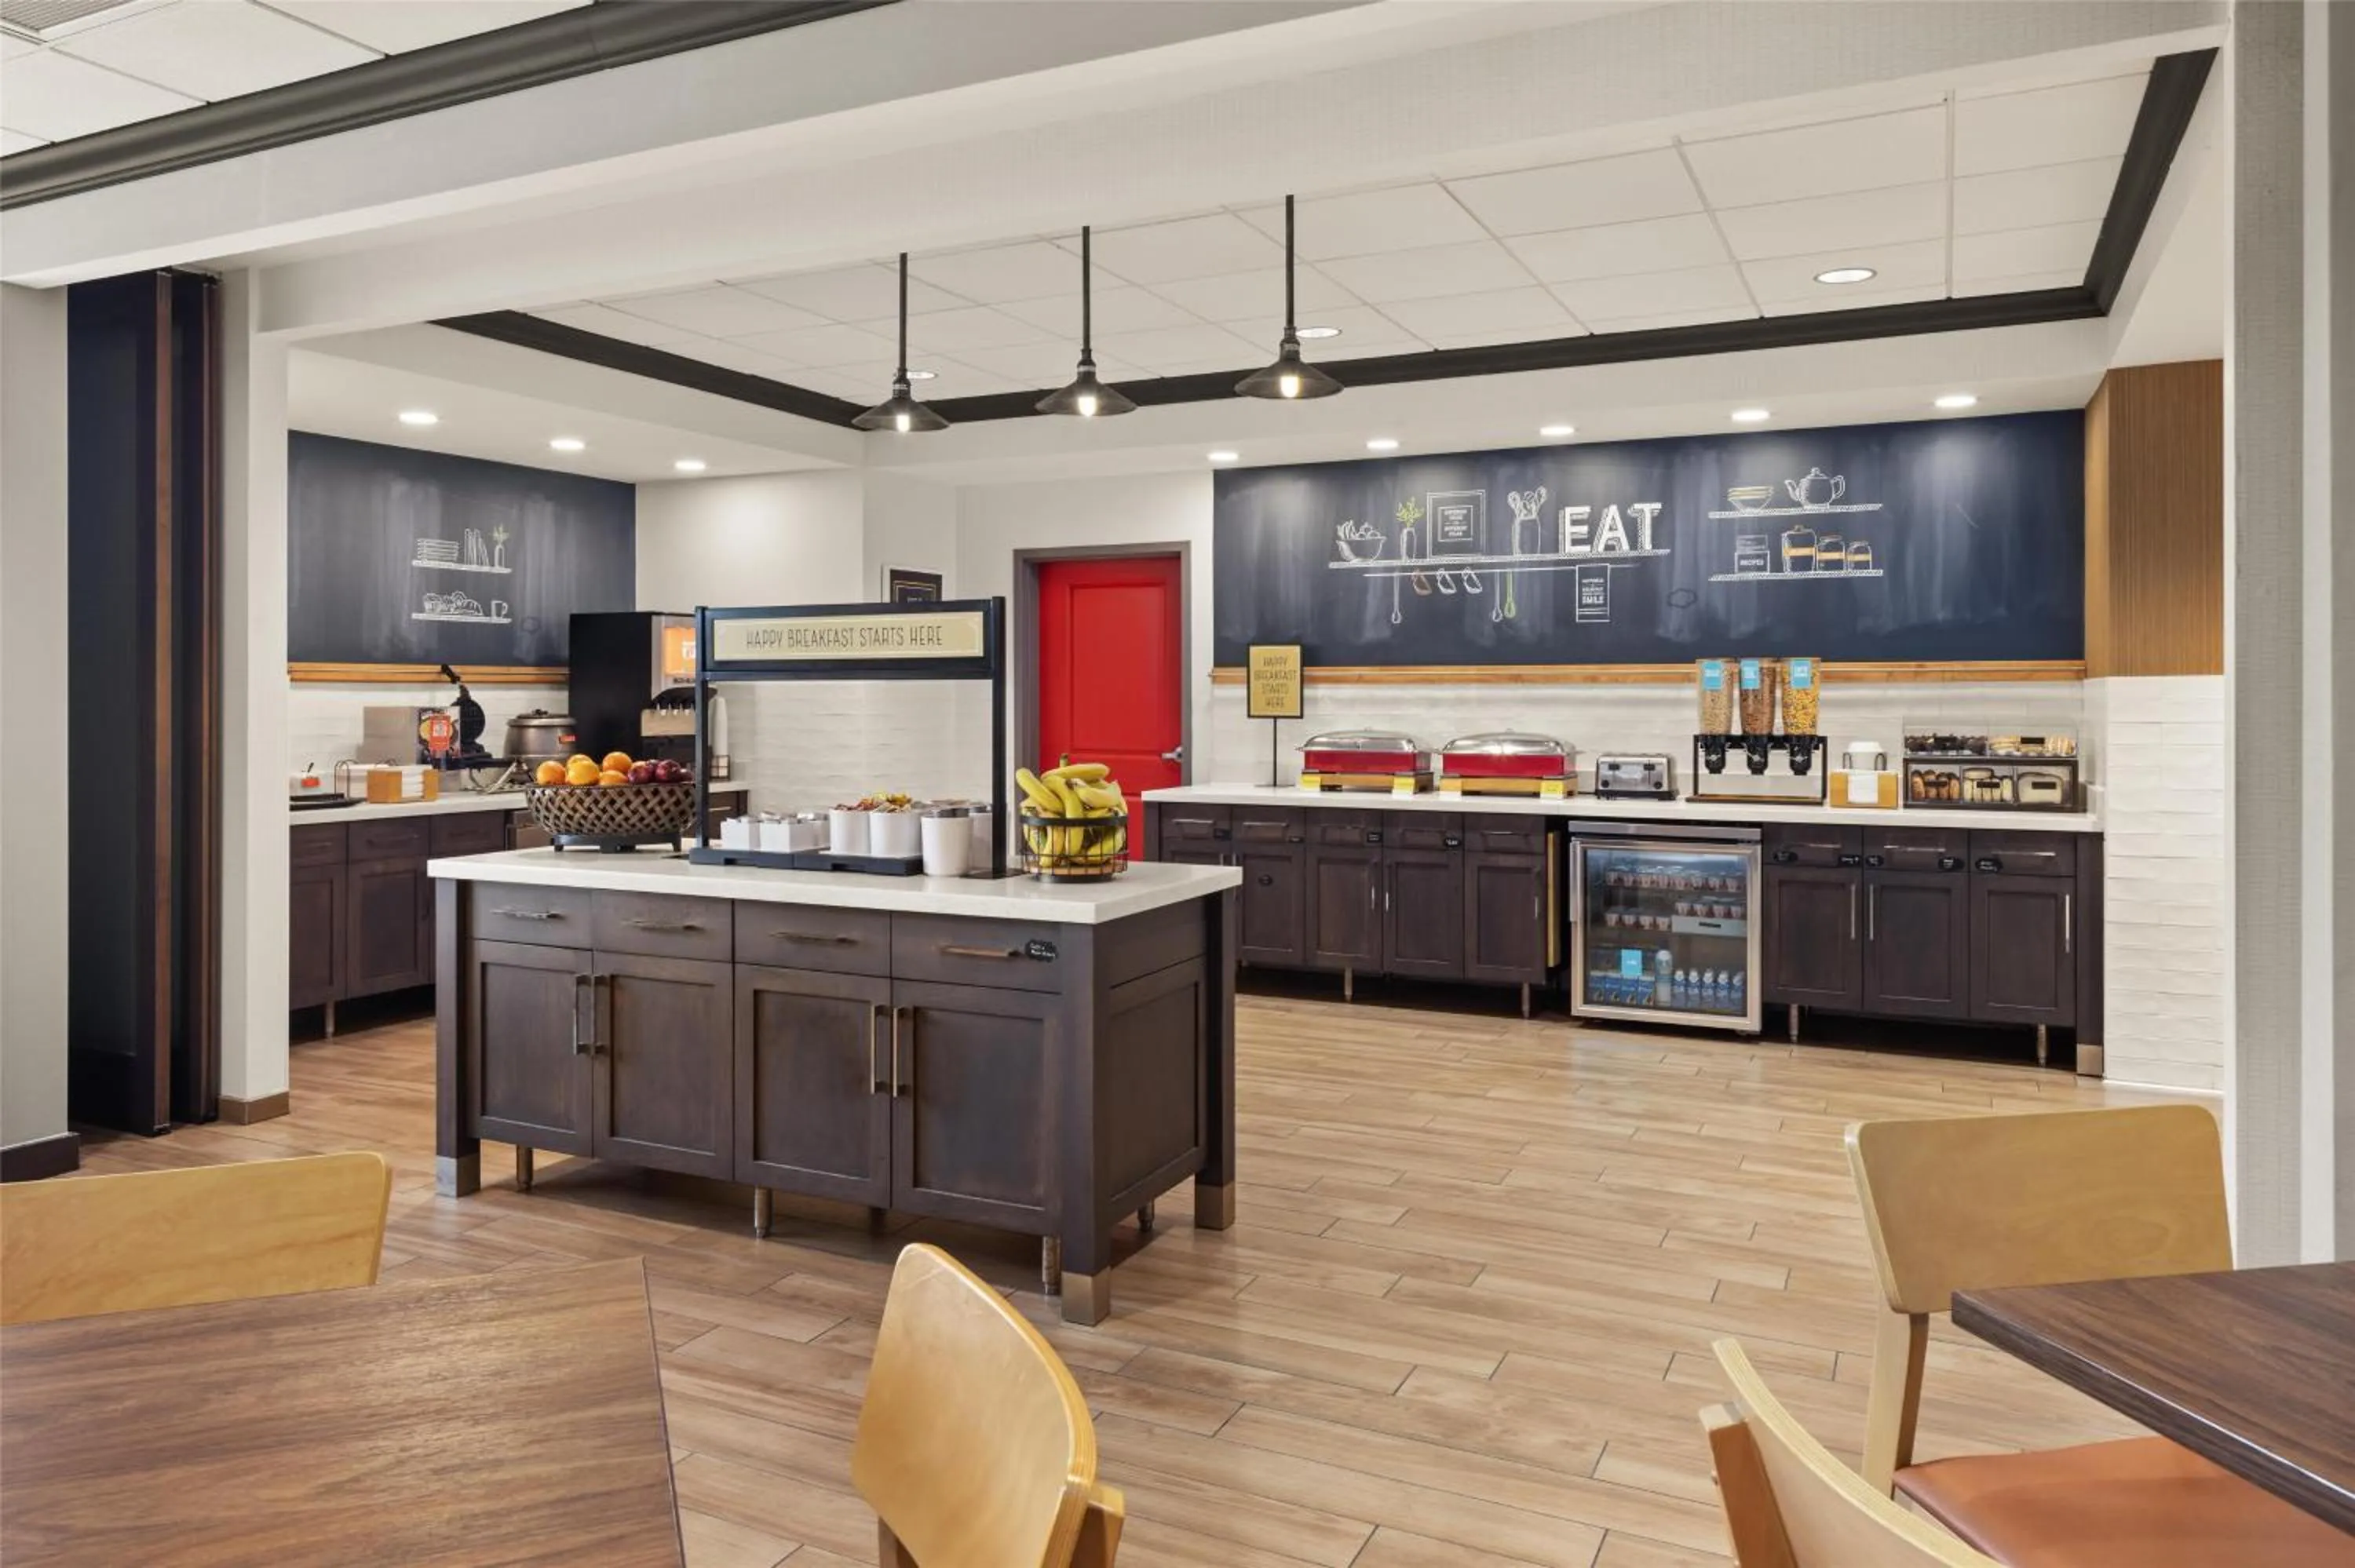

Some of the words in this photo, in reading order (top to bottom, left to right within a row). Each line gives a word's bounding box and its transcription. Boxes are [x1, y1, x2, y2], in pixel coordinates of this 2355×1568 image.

[1560, 502, 1662, 553] EAT
[747, 629, 783, 648] HAPPY
[787, 628, 854, 647] BREAKFAST
[860, 627, 904, 646] STARTS
[910, 625, 943, 646] HERE
